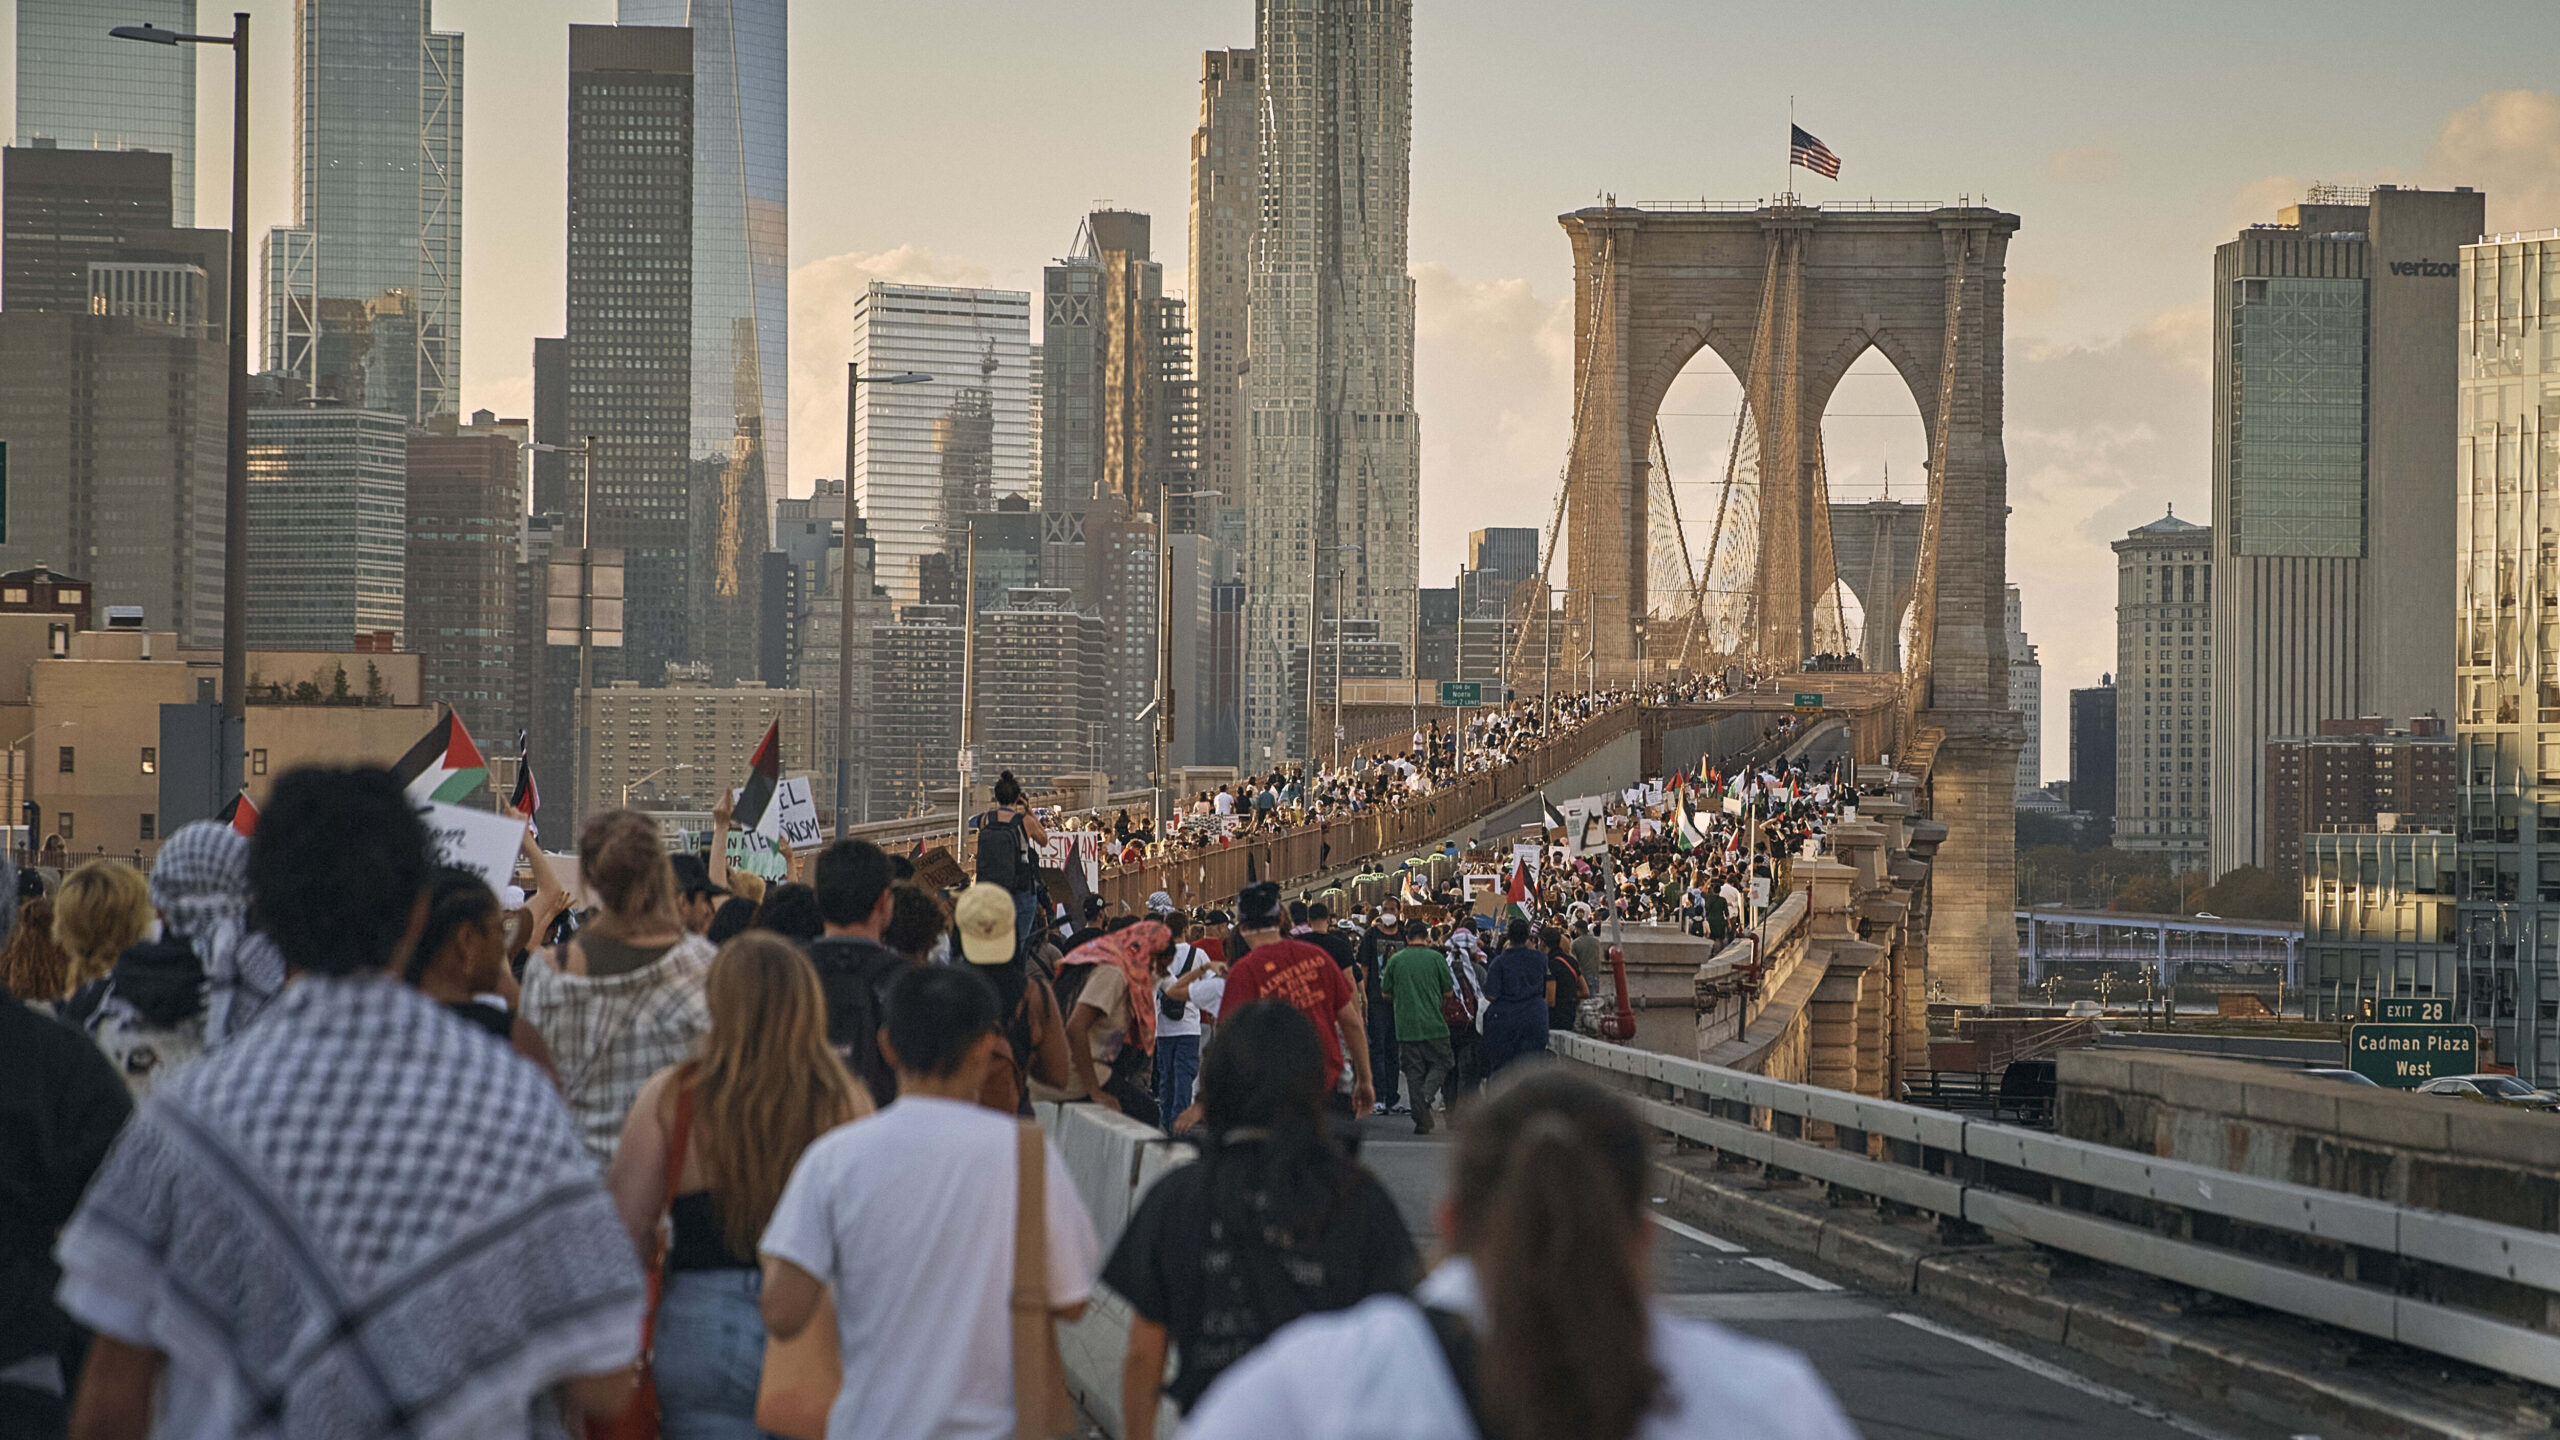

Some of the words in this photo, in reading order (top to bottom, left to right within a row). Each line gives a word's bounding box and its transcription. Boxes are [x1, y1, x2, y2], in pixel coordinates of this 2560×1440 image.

[2387, 1005, 2413, 1017] EXIT
[2422, 1003, 2443, 1021] 28
[2358, 1035, 2420, 1051] Cadman
[2428, 1035, 2470, 1051] Plaza
[2396, 1060, 2432, 1077] West
